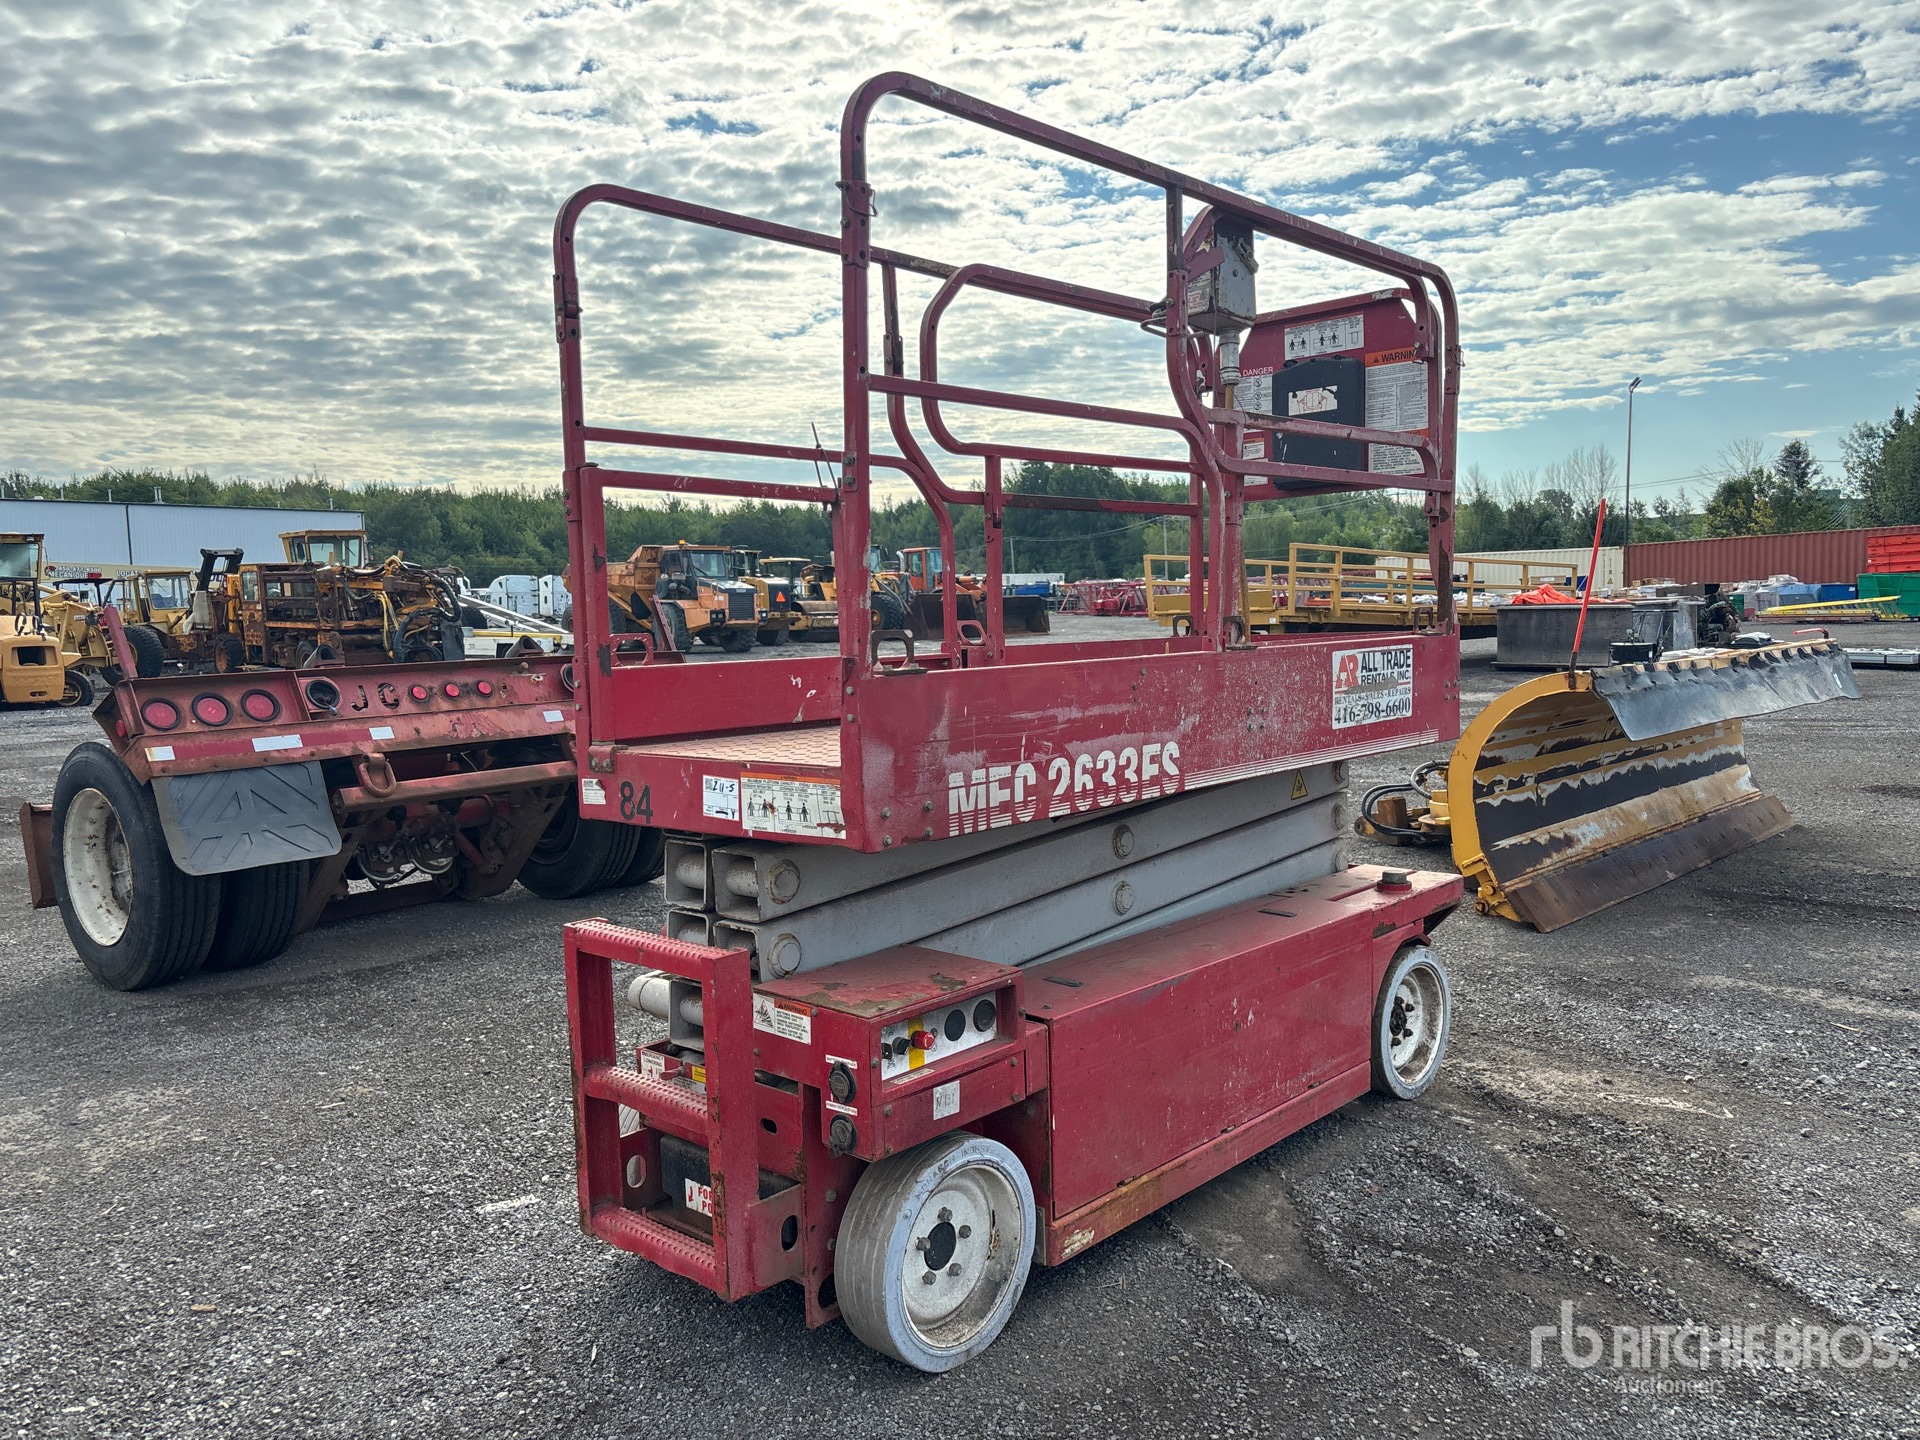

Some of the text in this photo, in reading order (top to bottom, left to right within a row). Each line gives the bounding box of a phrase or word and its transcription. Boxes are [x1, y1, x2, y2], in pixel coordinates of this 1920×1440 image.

[1381, 350, 1416, 362] WARNIN
[1242, 366, 1274, 377] DANGER
[1360, 649, 1411, 674] ALL TRADE
[1397, 669, 1411, 681] INC.
[1334, 697, 1411, 724] 416-798-6600
[949, 741, 1181, 837] MEC 2633ES
[621, 781, 653, 824] 84
